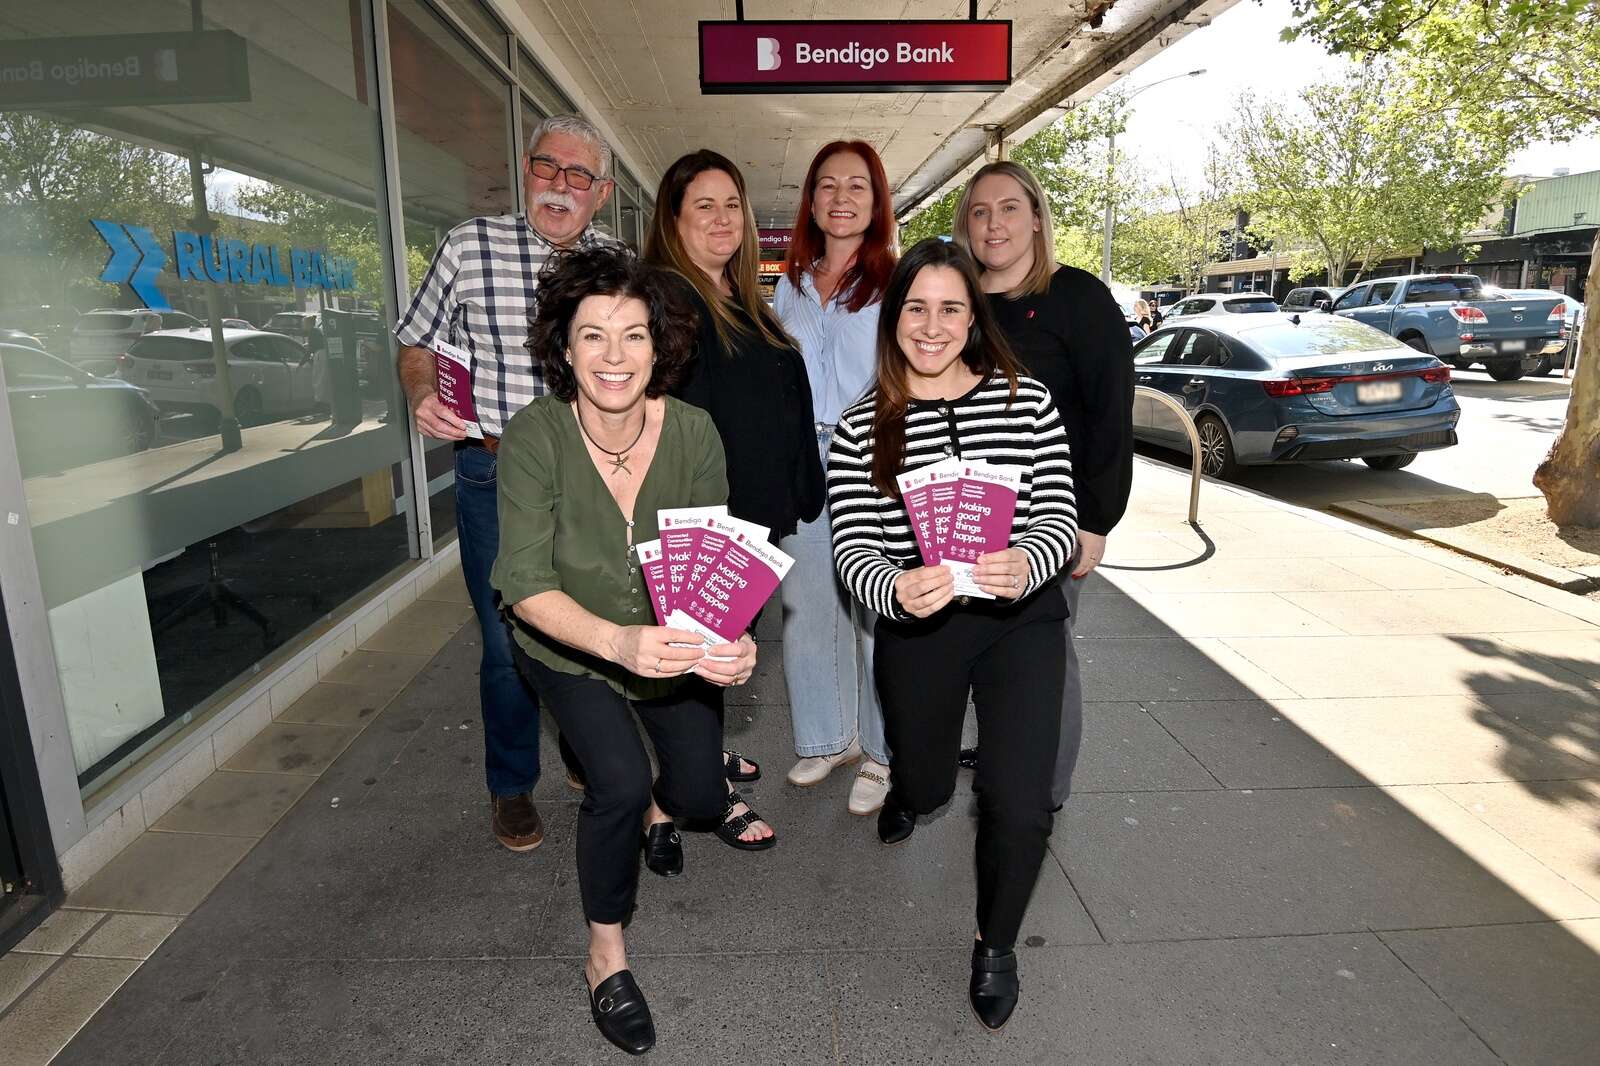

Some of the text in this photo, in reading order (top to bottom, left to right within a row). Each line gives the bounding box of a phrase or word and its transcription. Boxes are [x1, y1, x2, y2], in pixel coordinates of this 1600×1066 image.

[796, 42, 889, 70] Bendigo
[896, 41, 954, 63] Bank
[759, 235, 782, 244] endigo
[172, 231, 358, 290] RURAL BANK
[765, 263, 780, 272] BOX
[939, 471, 959, 479] Bendi
[973, 470, 998, 481] Bendigo
[998, 474, 1014, 482] Bank
[934, 503, 954, 514] Mak
[958, 501, 992, 516] Making
[674, 517, 702, 525] Bendigo
[956, 512, 981, 522] good
[717, 522, 736, 533] Bendi
[955, 520, 982, 534] things
[952, 530, 986, 544] happen
[669, 551, 691, 562] Mak
[745, 539, 769, 558] Bendigo
[769, 555, 783, 568] Bank
[710, 572, 735, 590] good
[717, 562, 748, 589] Making
[705, 579, 730, 600] things
[698, 587, 729, 613] happen
